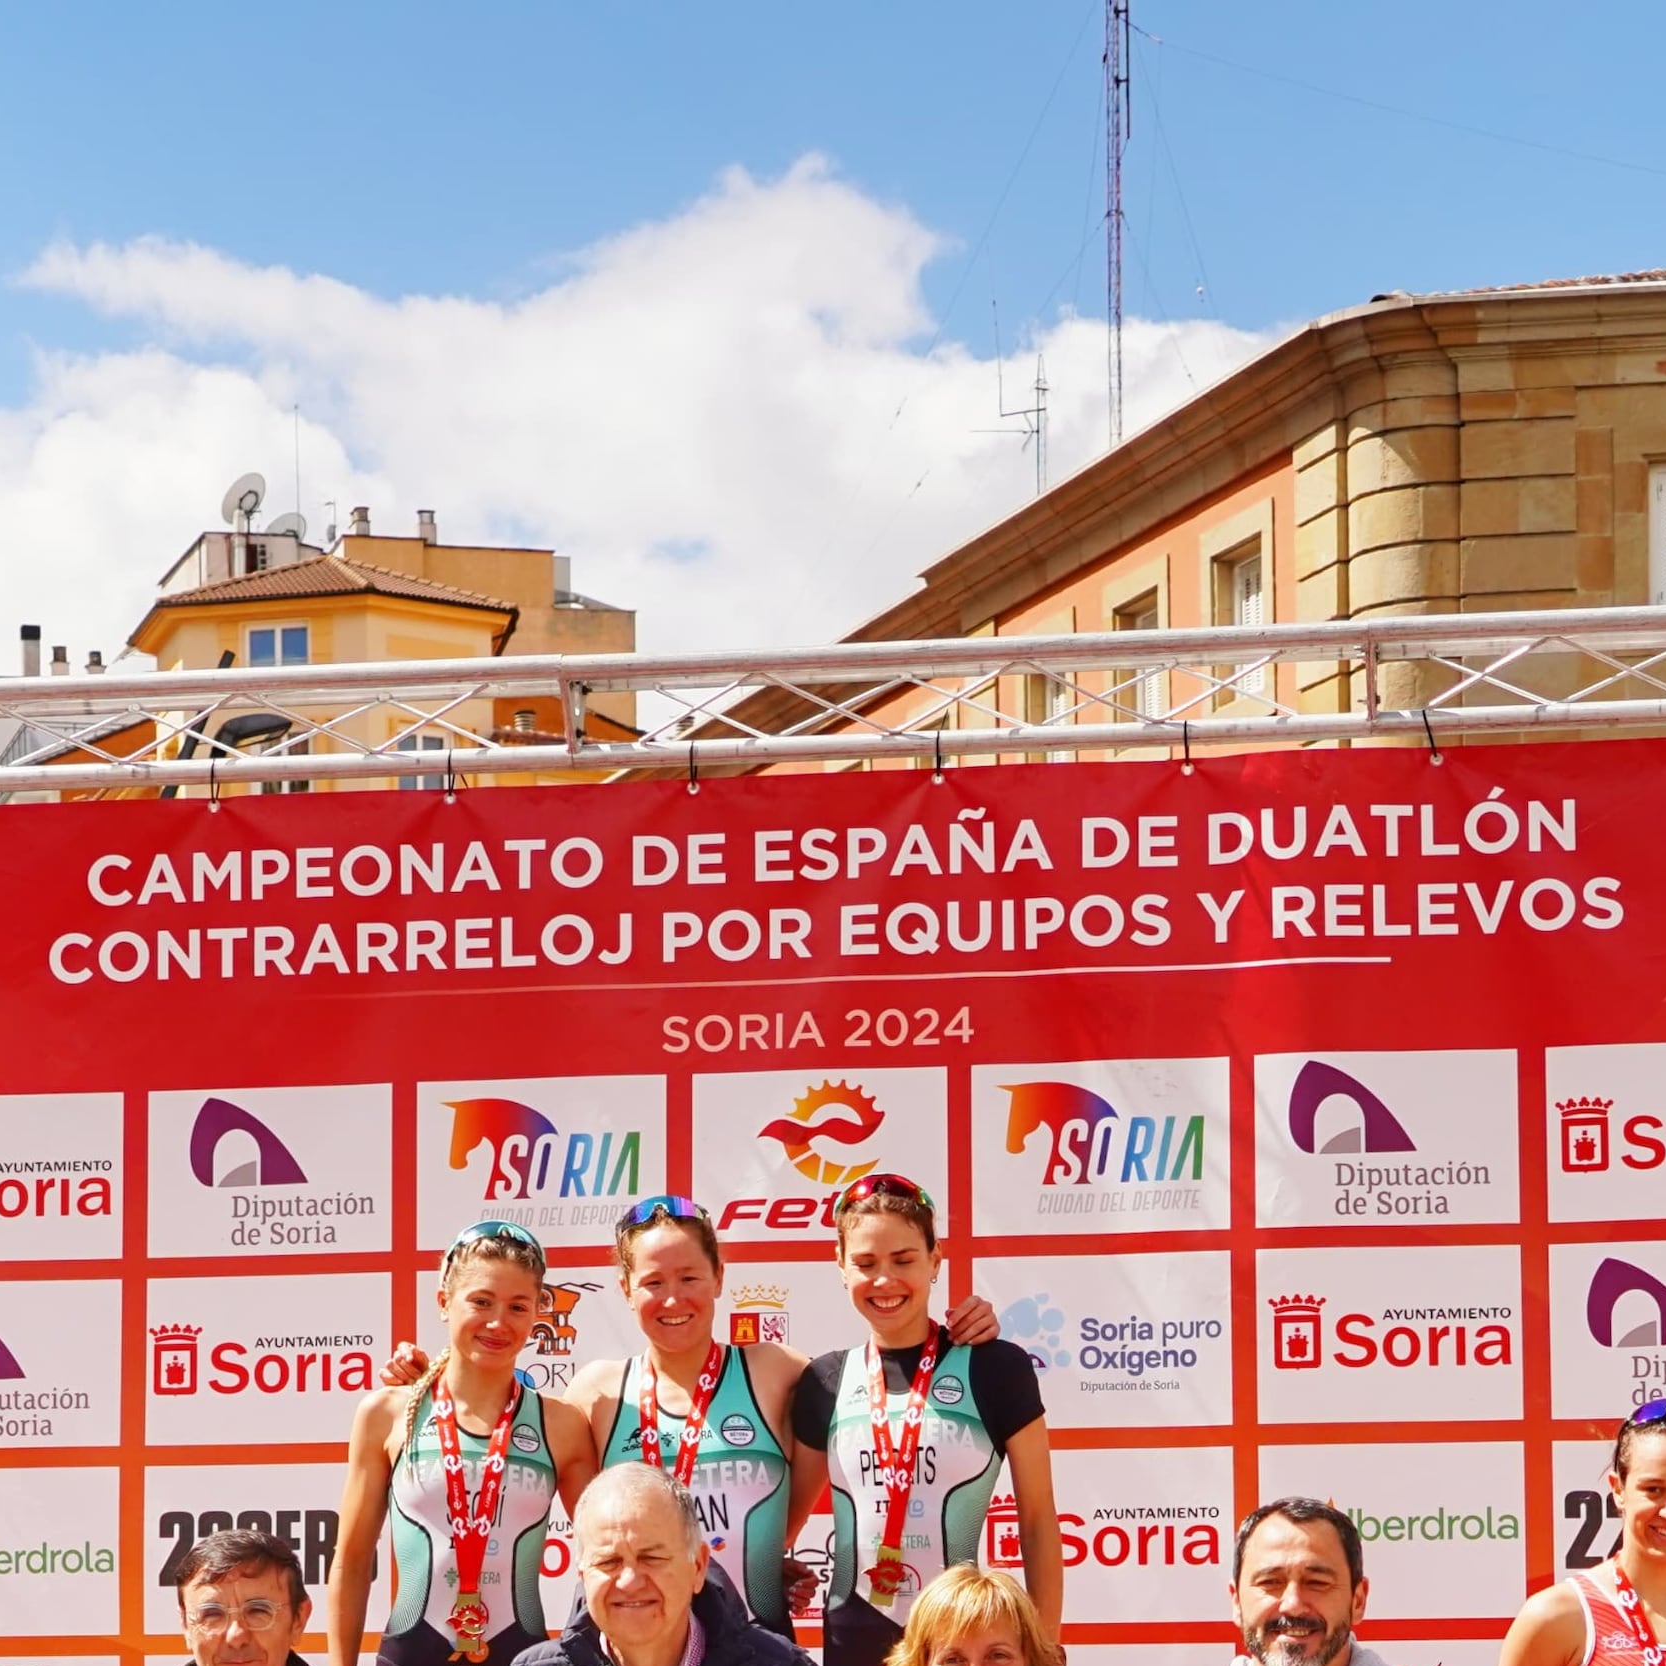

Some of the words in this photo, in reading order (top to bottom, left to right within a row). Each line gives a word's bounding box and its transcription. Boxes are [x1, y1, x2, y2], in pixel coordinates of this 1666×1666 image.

[86, 834, 603, 908] CAMPEONATO
[630, 834, 728, 888] DE
[753, 808, 1054, 884] ESPAÑA
[1079, 813, 1179, 870] DE
[1206, 786, 1578, 864] DUATLÓN
[48, 912, 636, 985] CONTRARRELOJ
[661, 904, 812, 964] POR
[838, 890, 1173, 956] EQUIPOS
[1197, 888, 1246, 943] Y
[1271, 876, 1625, 938] RELEVOS
[661, 1008, 826, 1056] SORIA
[842, 1006, 976, 1049] 2024
[494, 1132, 641, 1200] SORIA
[1045, 1113, 1205, 1186] SORIA
[1334, 1158, 1491, 1193] Diputación
[230, 1191, 377, 1224] Diputación
[538, 1206, 564, 1228] DEL
[1036, 1190, 1095, 1216] CIUDAD
[1099, 1190, 1130, 1213] DEL
[1133, 1188, 1201, 1212] DEPORTE
[1334, 1191, 1372, 1215] de
[1378, 1189, 1450, 1214] Soria
[230, 1222, 273, 1245] de
[279, 1220, 338, 1244] Soria
[1080, 1317, 1154, 1342] Soria
[1161, 1317, 1221, 1342] puro
[1382, 1306, 1512, 1322] AYUNTAMIENTO
[254, 1334, 374, 1349] AYUNTAMIENTO
[1333, 1314, 1512, 1369] Soria
[209, 1342, 373, 1395] Soria
[1079, 1344, 1197, 1377] Oxígeno
[1080, 1379, 1136, 1393] Diputación
[1139, 1380, 1151, 1390] de
[1154, 1379, 1180, 1391] Soria
[1632, 1381, 1662, 1404] de
[1093, 1506, 1220, 1521] AYUNTAMIENTO
[1059, 1510, 1220, 1567] Soria
